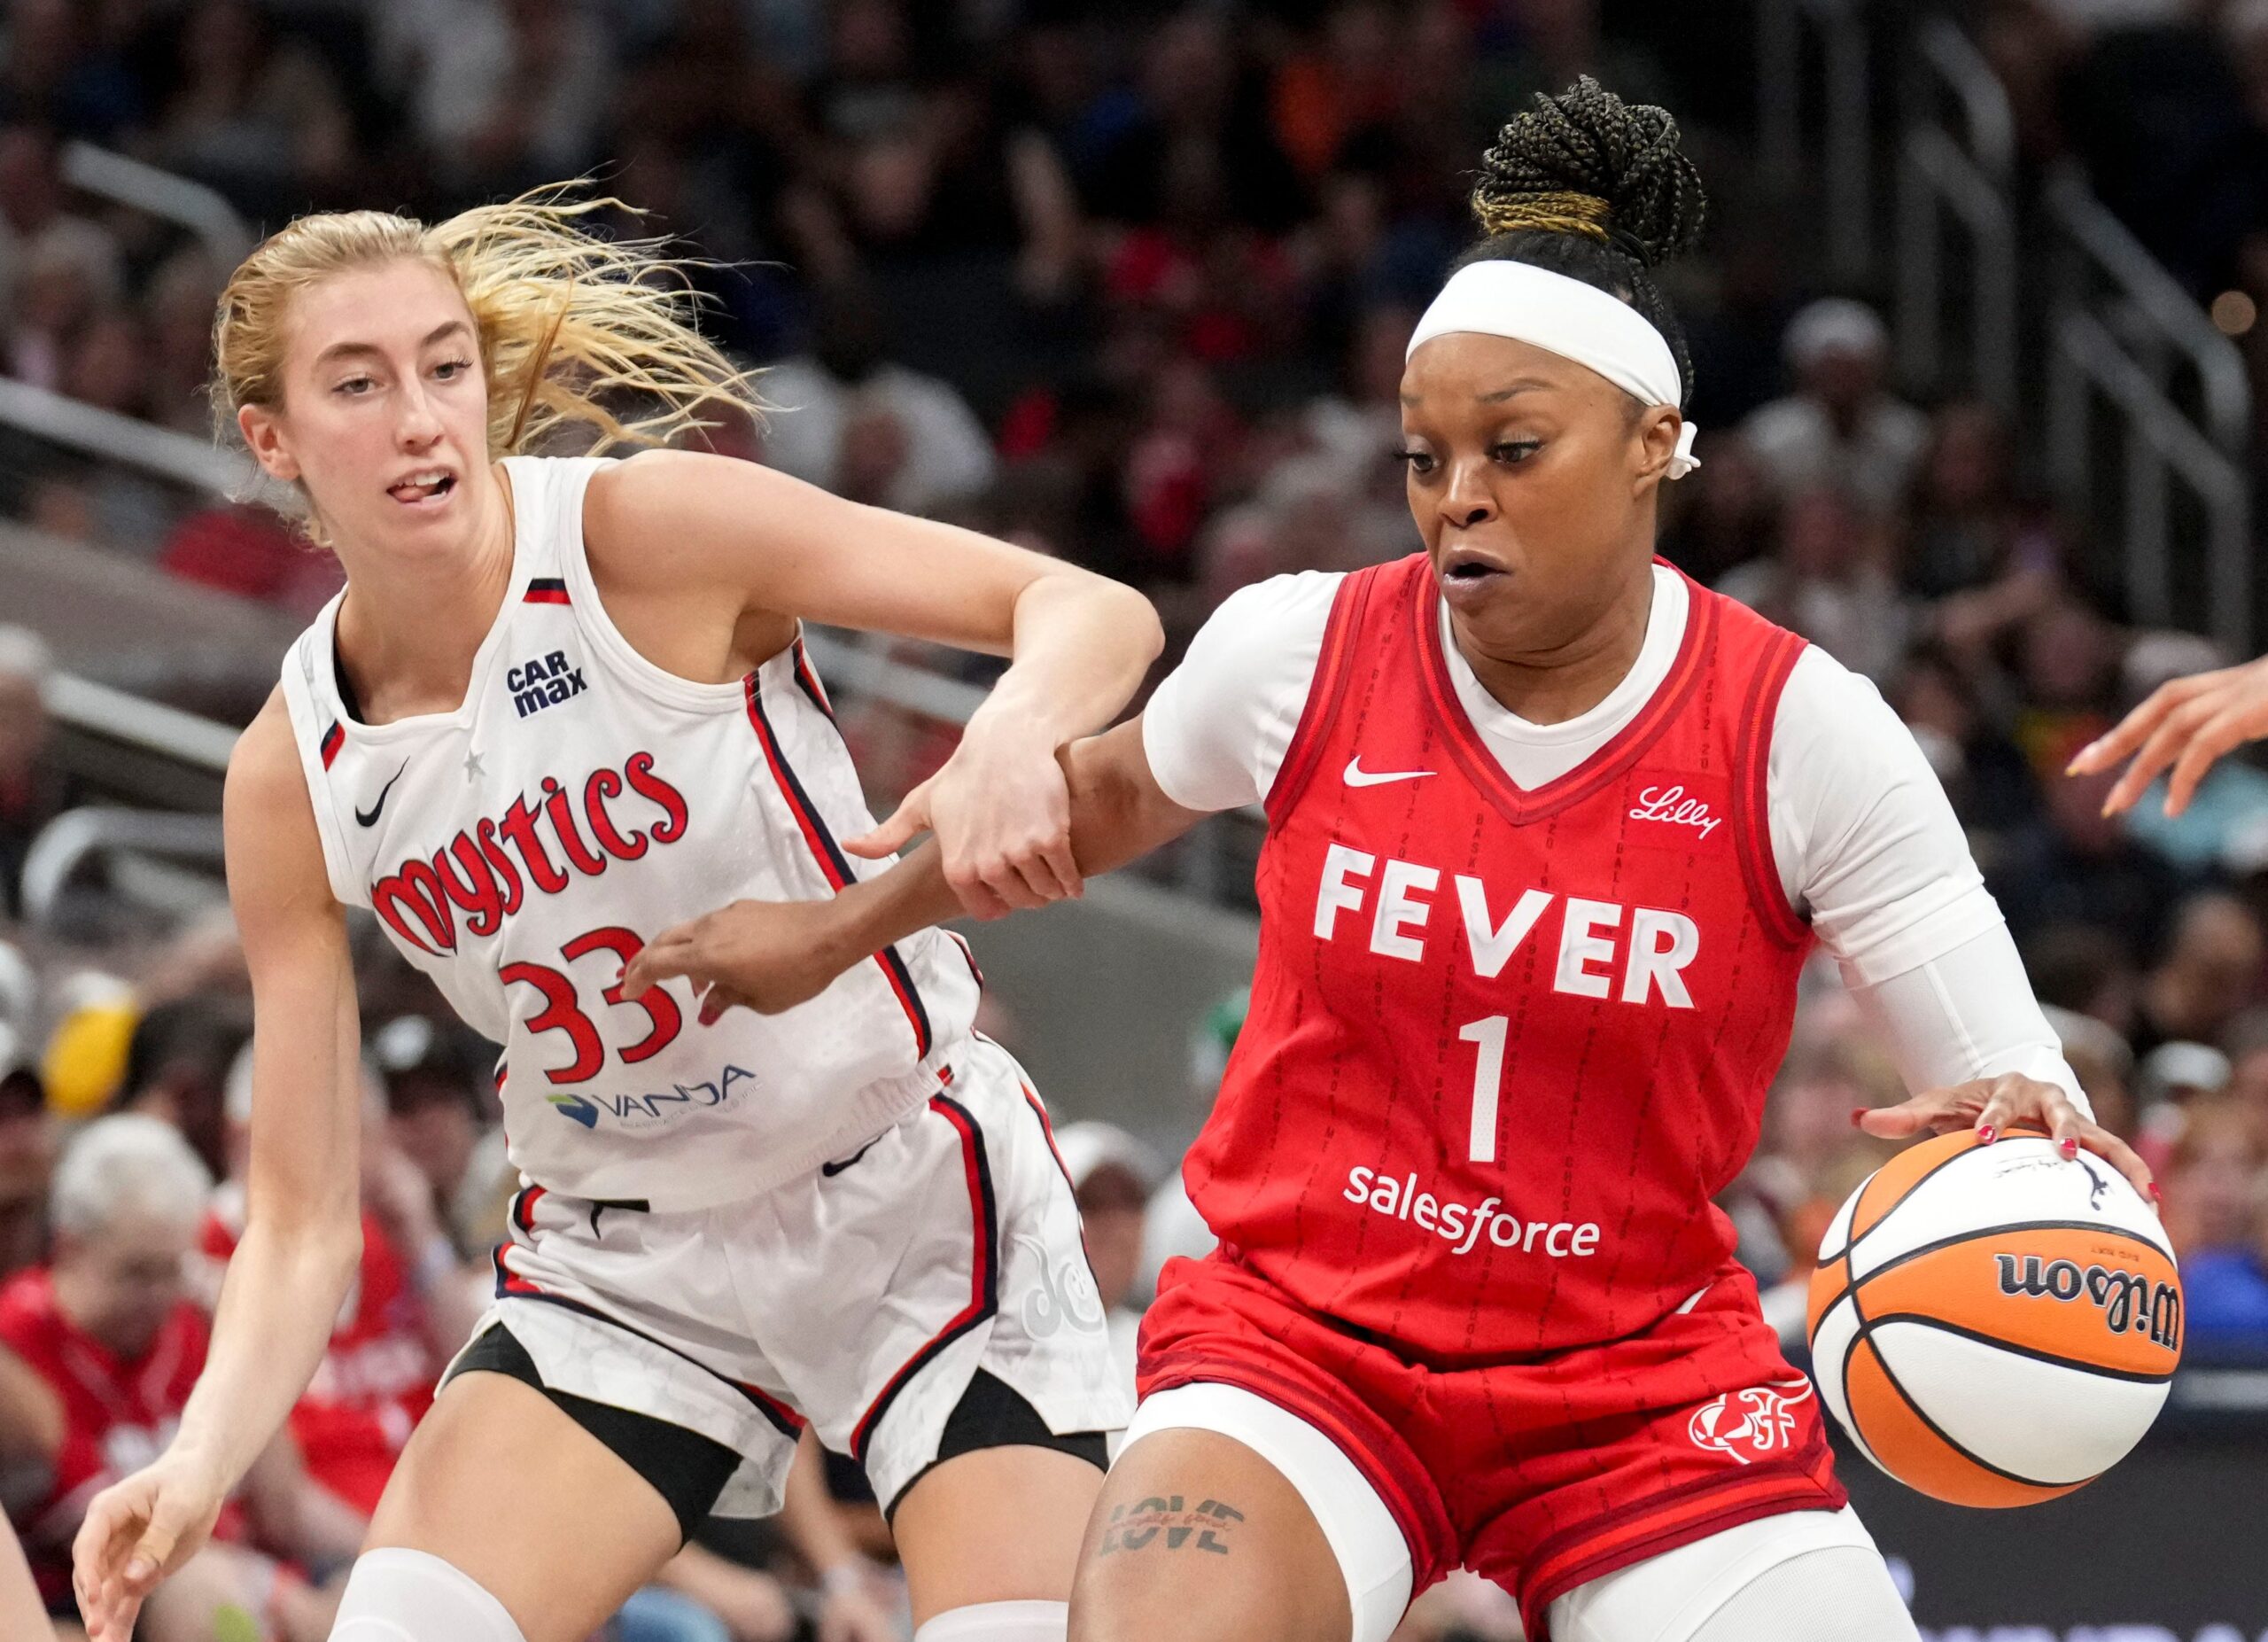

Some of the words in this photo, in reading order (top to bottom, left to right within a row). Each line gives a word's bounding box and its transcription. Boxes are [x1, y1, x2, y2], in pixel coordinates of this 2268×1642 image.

[507, 650, 570, 693] CAR
[514, 666, 587, 719] max
[371, 751, 688, 957] mystics
[1628, 785, 1721, 840] Lilly
[1312, 841, 1701, 1009] FEVER
[499, 926, 682, 1085] 33
[1458, 1014, 1509, 1163] 1
[1342, 1164, 1601, 1257] salesforce
[1994, 1253, 2180, 1353] Wilson
[1100, 1495, 1244, 1555] LOVE
